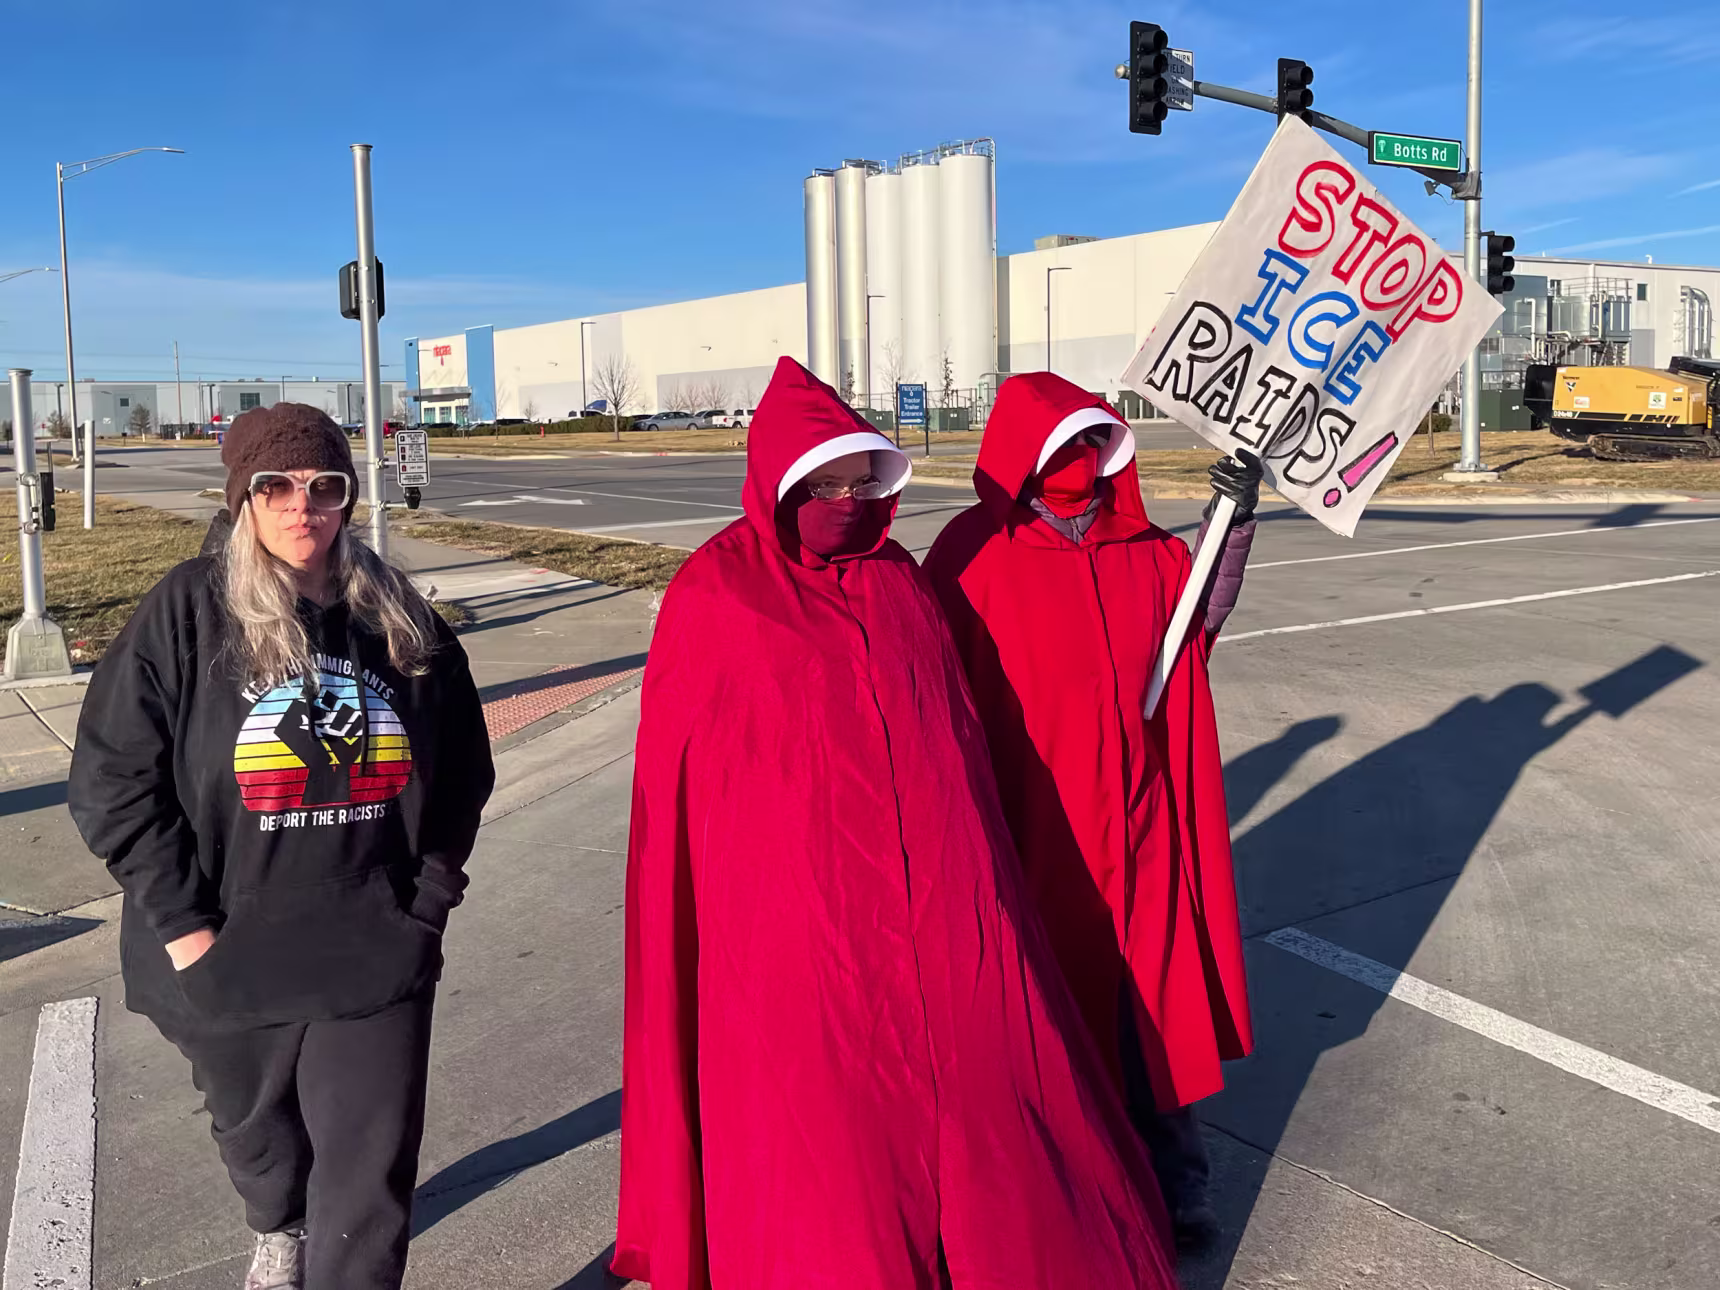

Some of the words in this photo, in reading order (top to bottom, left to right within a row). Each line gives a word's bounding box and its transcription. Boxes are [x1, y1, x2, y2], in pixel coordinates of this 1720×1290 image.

[1176, 53, 1191, 63] TURN
[1168, 86, 1189, 97] ASHING
[1394, 143, 1428, 160] Botts
[1432, 147, 1447, 162] Rd
[1278, 160, 1463, 343] STOP
[1235, 248, 1393, 405] ICE
[1144, 301, 1399, 508] RAIDS!
[310, 653, 394, 700] IMMIGANTS
[260, 812, 308, 831] DEPORT
[312, 810, 335, 827] THE
[338, 803, 387, 825] RACISTS
